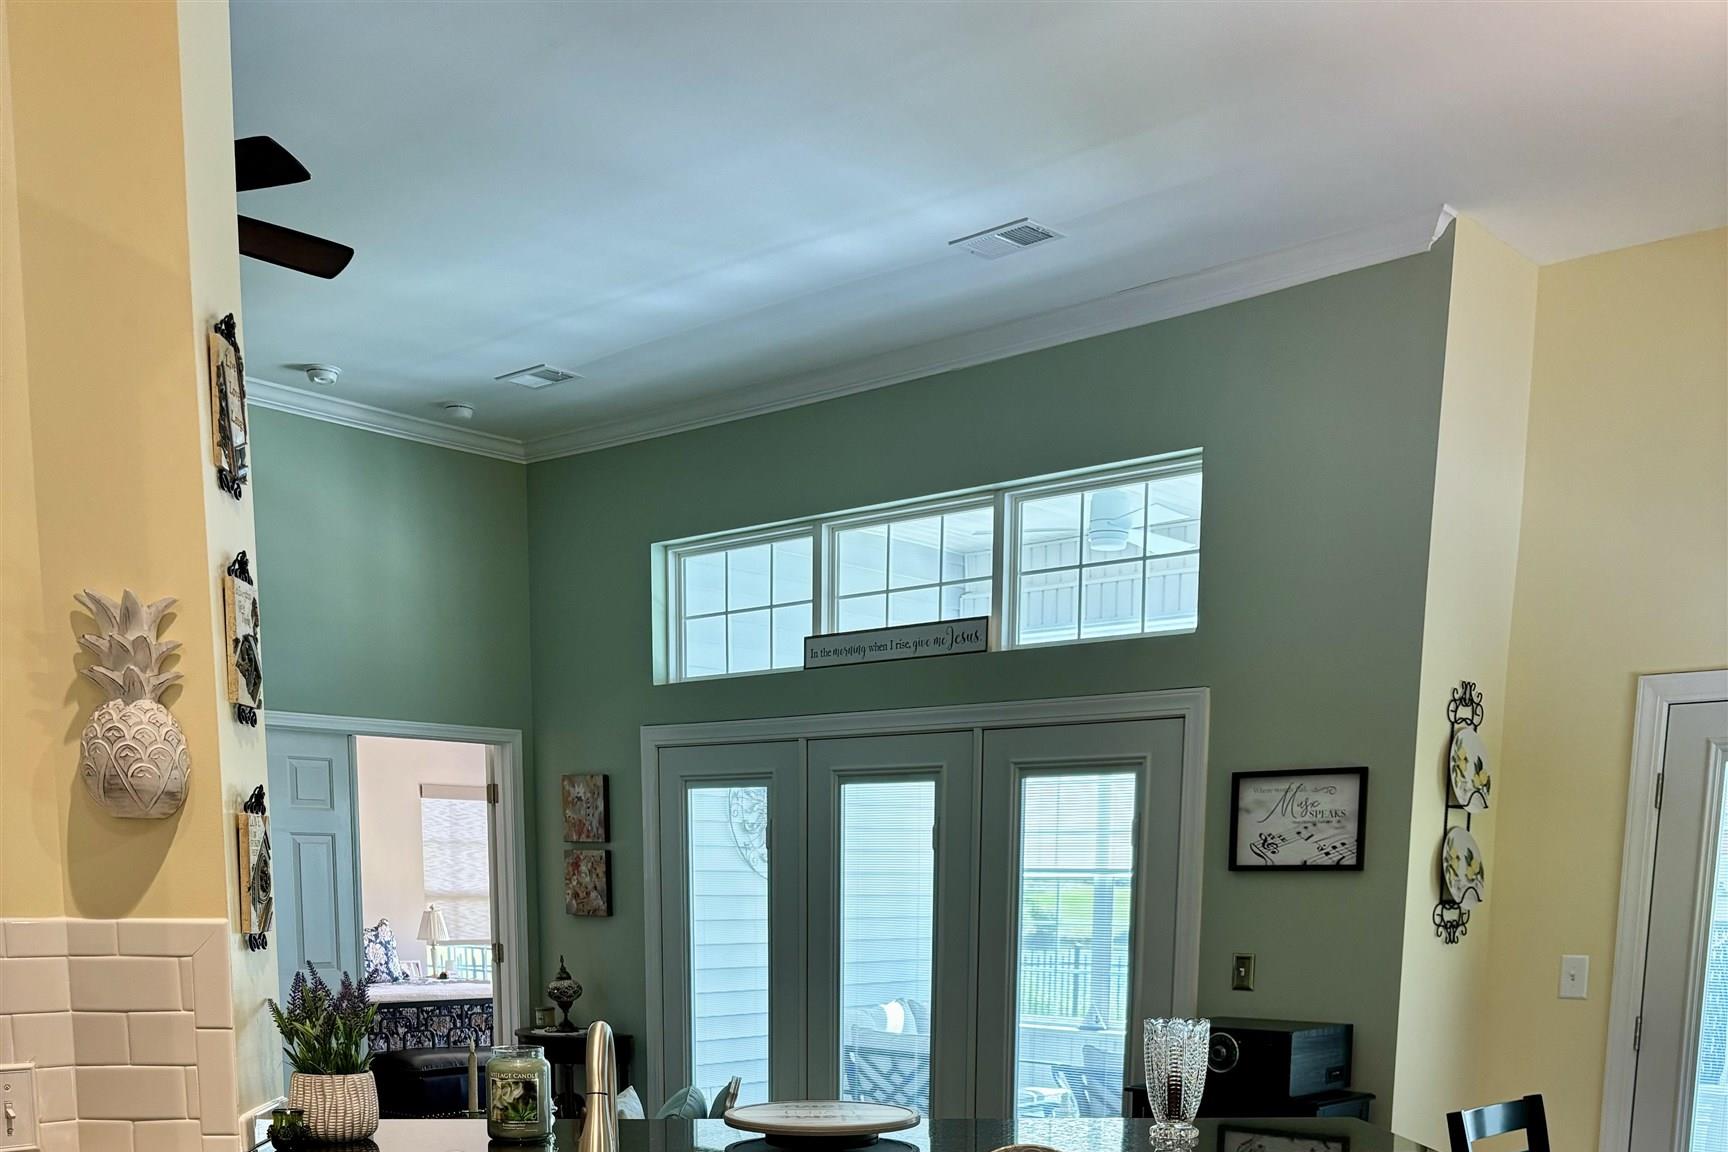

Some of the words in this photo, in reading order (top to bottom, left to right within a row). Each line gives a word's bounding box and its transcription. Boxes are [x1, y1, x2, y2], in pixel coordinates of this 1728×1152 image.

[810, 648, 818, 659] In
[820, 647, 831, 658] the
[832, 644, 866, 660] morning
[868, 641, 888, 653] when
[890, 639, 894, 650] I
[912, 636, 931, 654] give
[933, 636, 946, 647] me
[1309, 809, 1346, 819] SPEAKS
